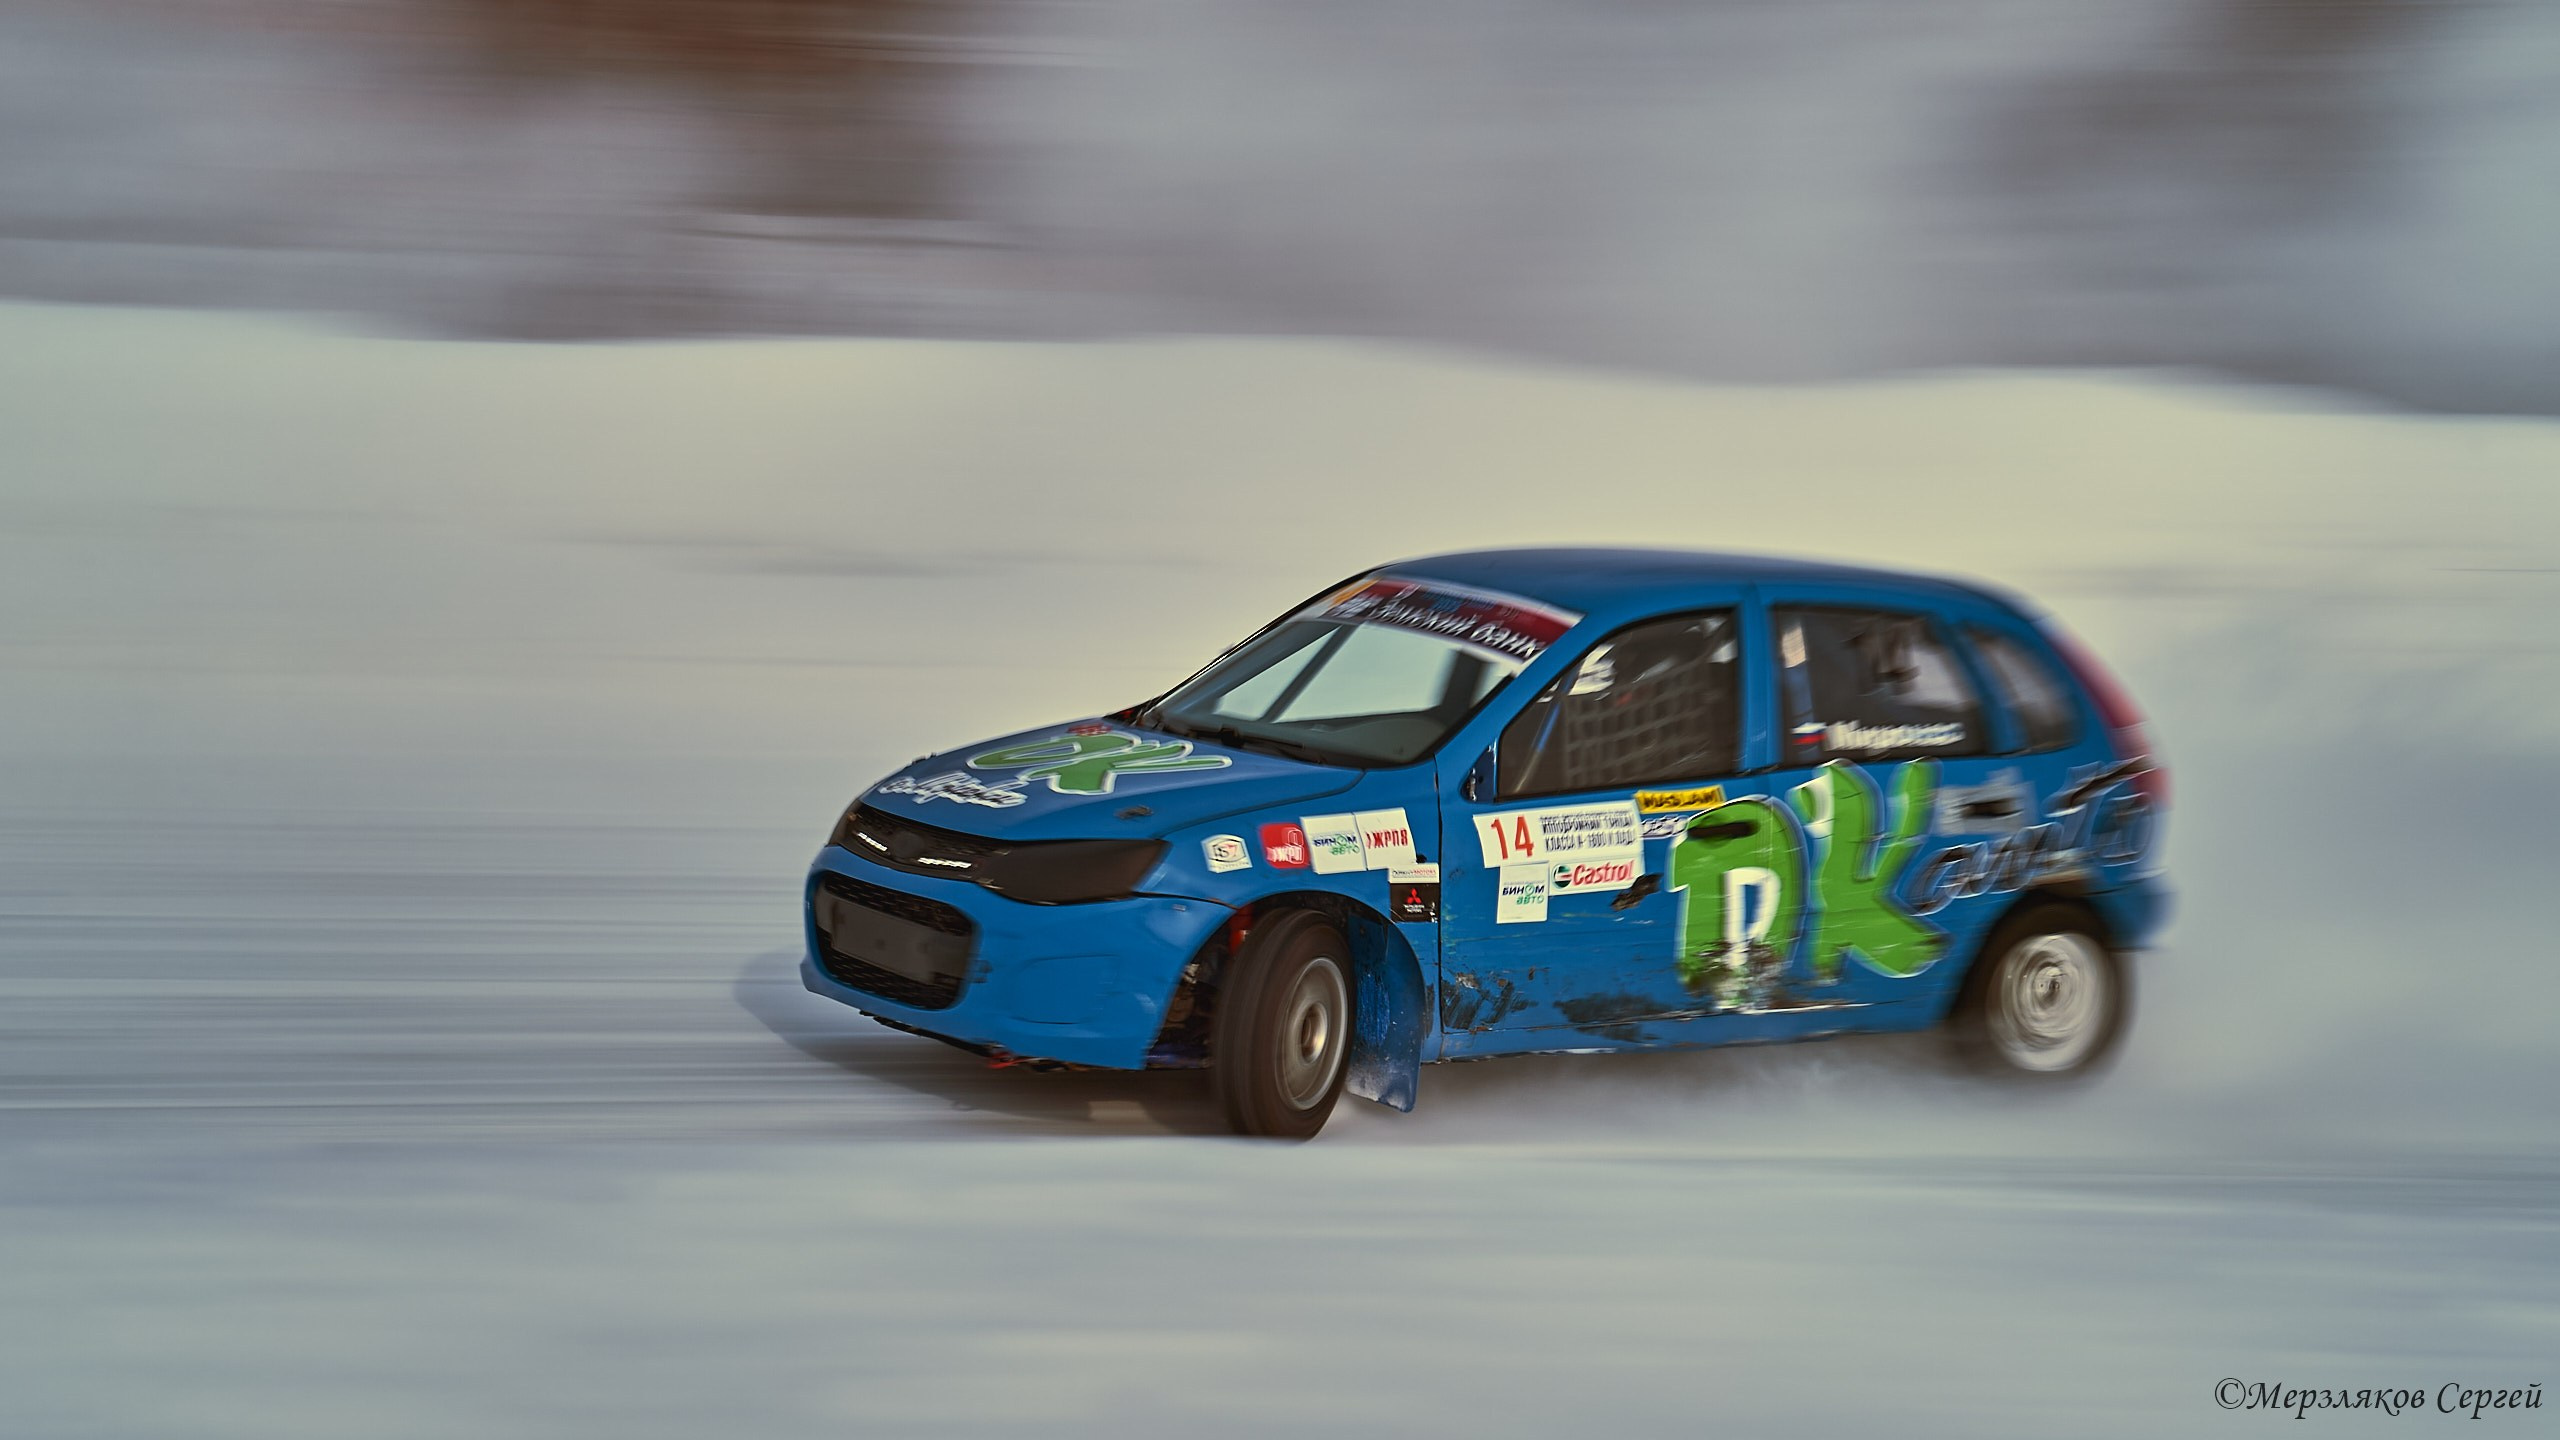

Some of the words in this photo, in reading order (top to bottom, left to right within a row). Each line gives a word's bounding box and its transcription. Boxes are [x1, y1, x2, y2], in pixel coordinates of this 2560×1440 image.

[1491, 815, 1534, 860] 14
[1572, 860, 1634, 886] Castrol
[1502, 884, 1545, 896] БИНОМ
